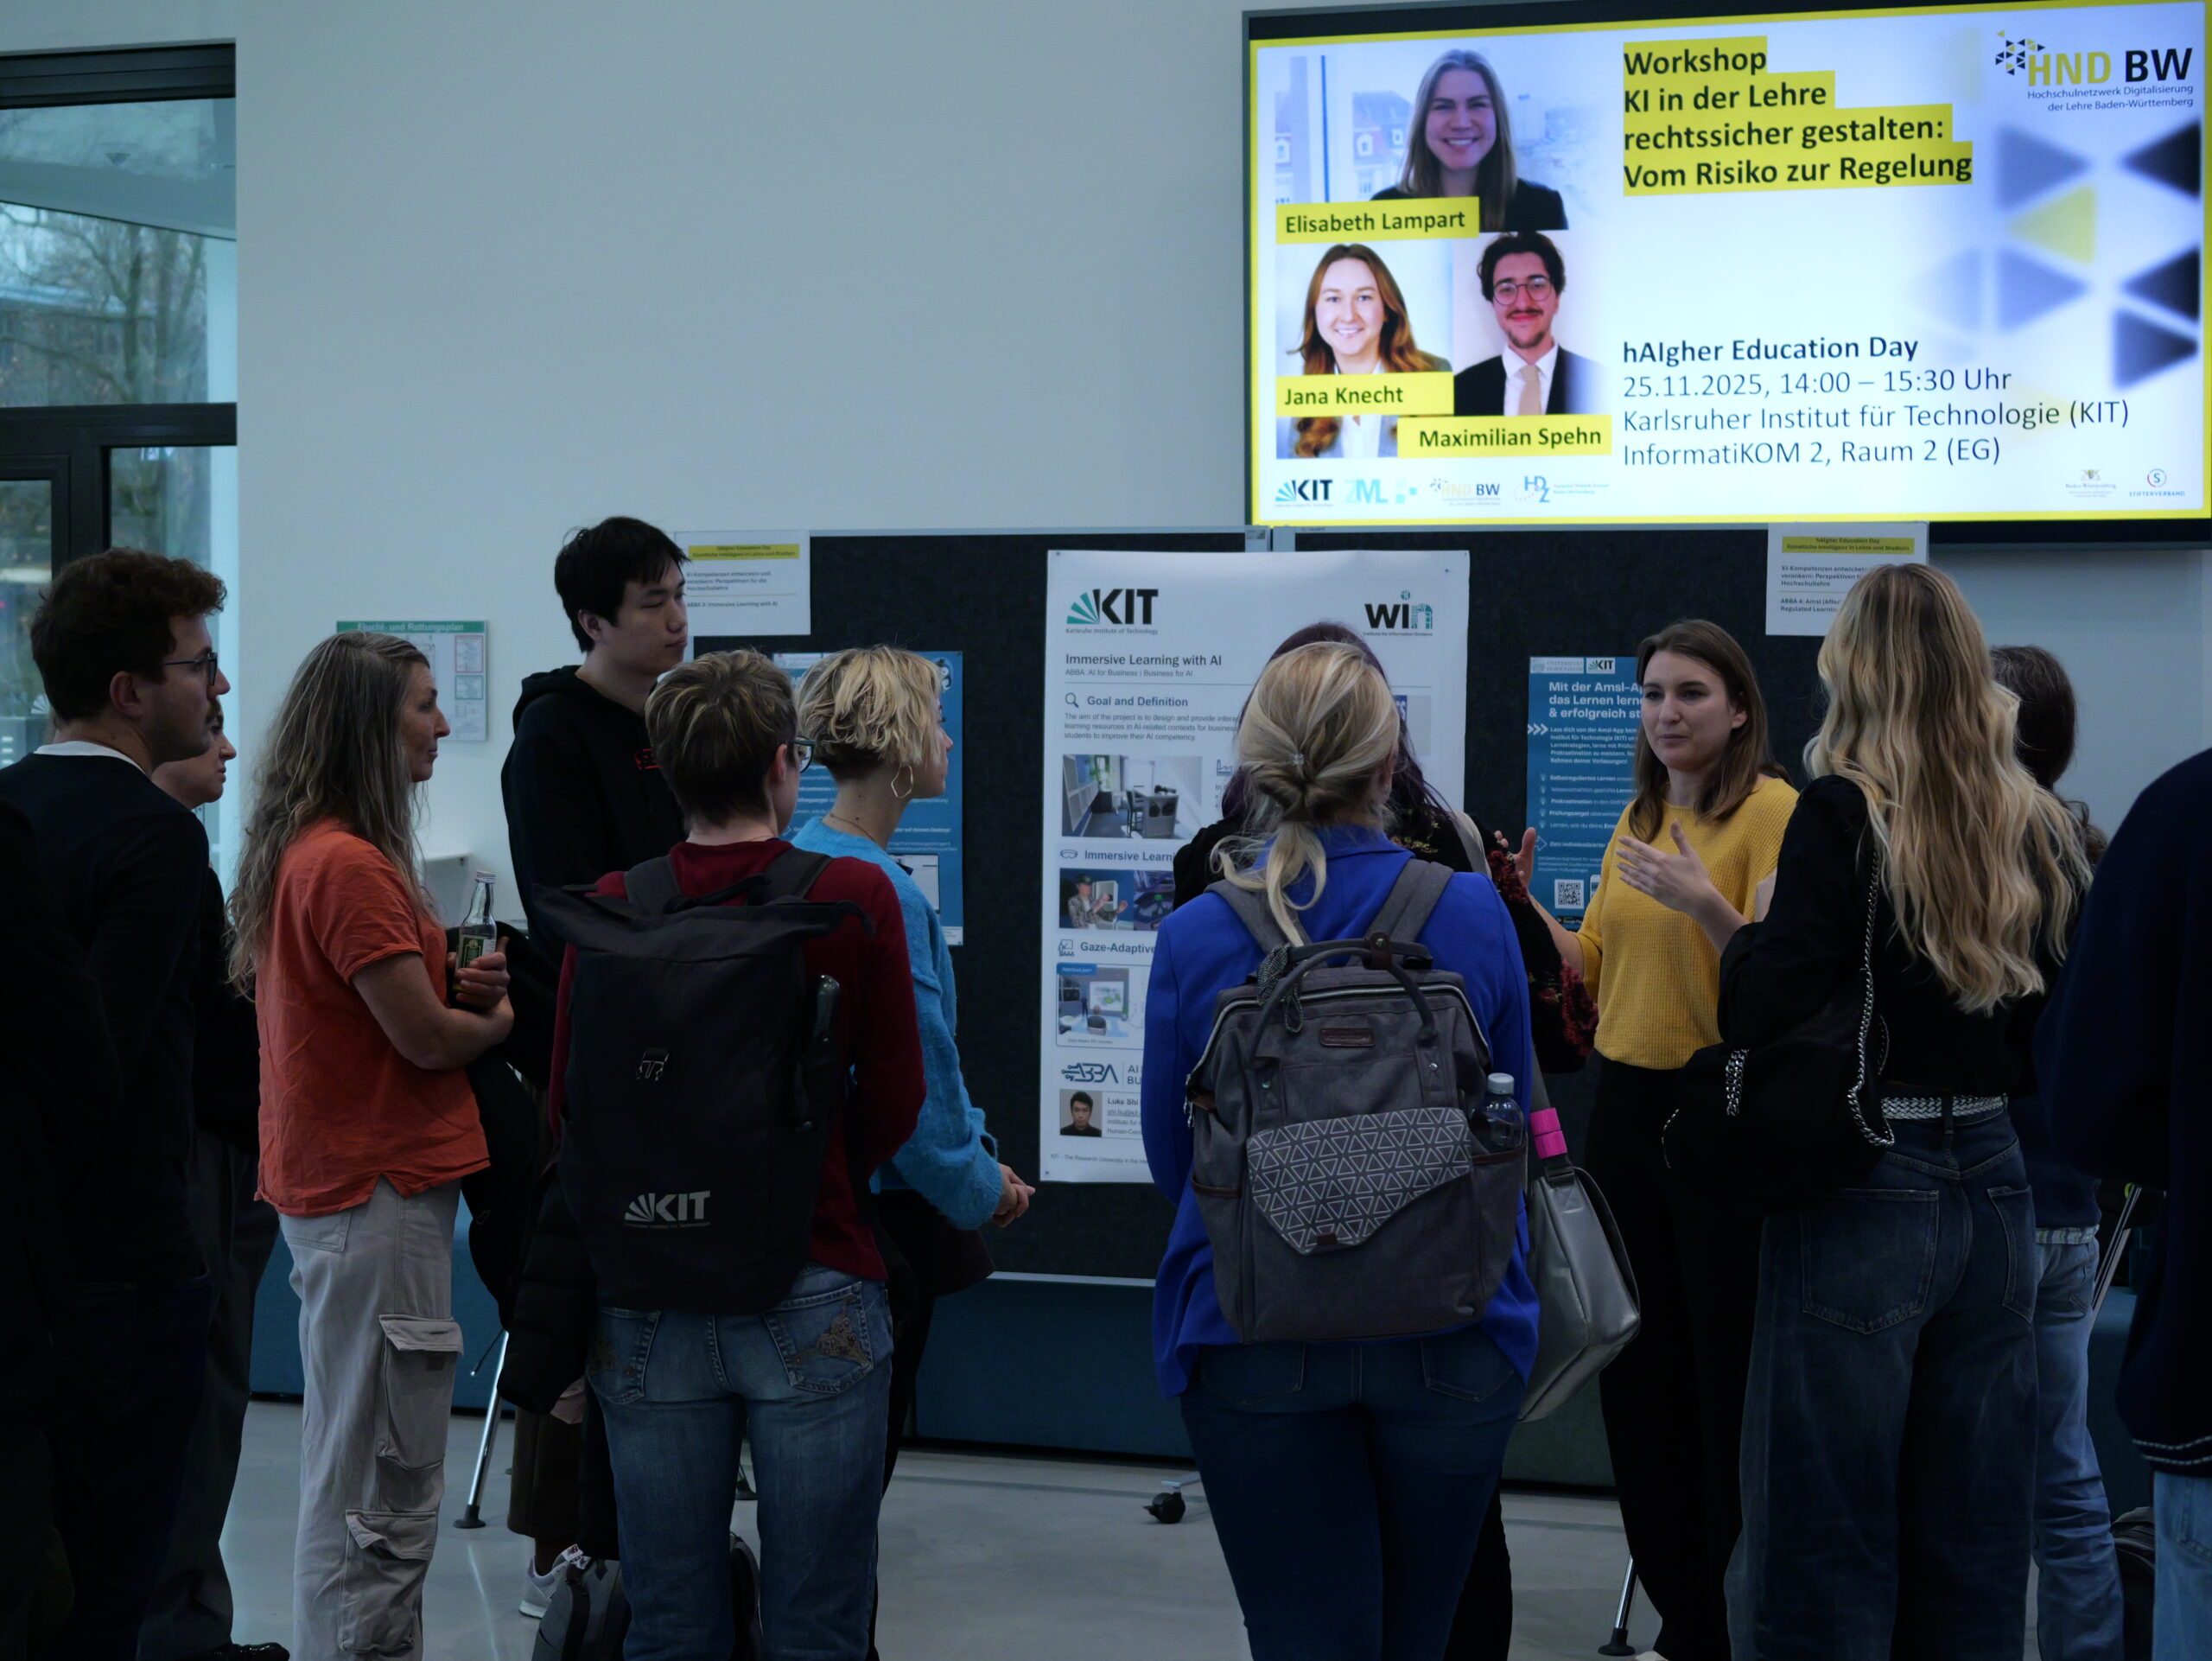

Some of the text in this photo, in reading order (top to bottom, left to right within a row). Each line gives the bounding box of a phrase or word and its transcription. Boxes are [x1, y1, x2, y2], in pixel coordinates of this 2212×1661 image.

[1624, 48, 1767, 75] Workshop
[2028, 48, 2193, 86] HND BW
[1624, 82, 1827, 112] KI in der Lehre
[2028, 85, 2193, 99] Hochschulnetzwerk Digitalisierung
[2048, 97, 2193, 111] der Lehre Baden-Württemberg
[1624, 116, 1944, 150] rechtssicher gestalten:
[1624, 153, 1972, 188] Vom Risiko zur Regelung
[1285, 210, 1466, 234] Elisabeth Lampart
[1623, 335, 1918, 369] hAIgher Education Day
[1623, 374, 1770, 399] 25.11.2025,
[1780, 371, 1851, 394] 14:00
[1884, 369, 1955, 392] 15:30
[1964, 366, 2012, 391] Uhr
[1285, 383, 1404, 407] Jana Knecht
[1624, 398, 2129, 432] Karlsruher Institut für Technologie (KIT)
[1420, 426, 1602, 449] Maximilian Spehn
[1624, 436, 2000, 468] InformatiKOM 2, Raum 2 (EG)
[1292, 479, 1333, 501] KIT
[1476, 483, 1501, 496] BW
[1782, 565, 1833, 574] KI-Kompetenzen
[1092, 589, 1159, 625] KIT
[1364, 590, 1433, 629] win
[407, 623, 464, 633] Rettungsplan
[1127, 627, 1159, 636] Technology
[1065, 653, 1222, 668] Immersive Learning with AI
[1596, 660, 1614, 671] KIT
[1108, 669, 1138, 678] Business
[1143, 670, 1173, 678] Business
[1549, 681, 1642, 694] Mit der Amsl-A
[1087, 696, 1188, 707] Goal and Definition
[1549, 695, 1570, 704] das
[1573, 695, 1613, 705] Lernen
[1113, 714, 1135, 723] project
[1153, 714, 1176, 724] design
[1177, 714, 1190, 722] and
[1191, 715, 1216, 724] provide
[1548, 708, 1641, 721] & erfolgreich st
[1065, 723, 1090, 733] learning
[1102, 733, 1128, 741] improve
[1084, 850, 1175, 862] Immersive Learni
[1080, 941, 1155, 955] Gaze-Adaptive
[1128, 1064, 1139, 1074] AI
[649, 1190, 710, 1221] KIT
